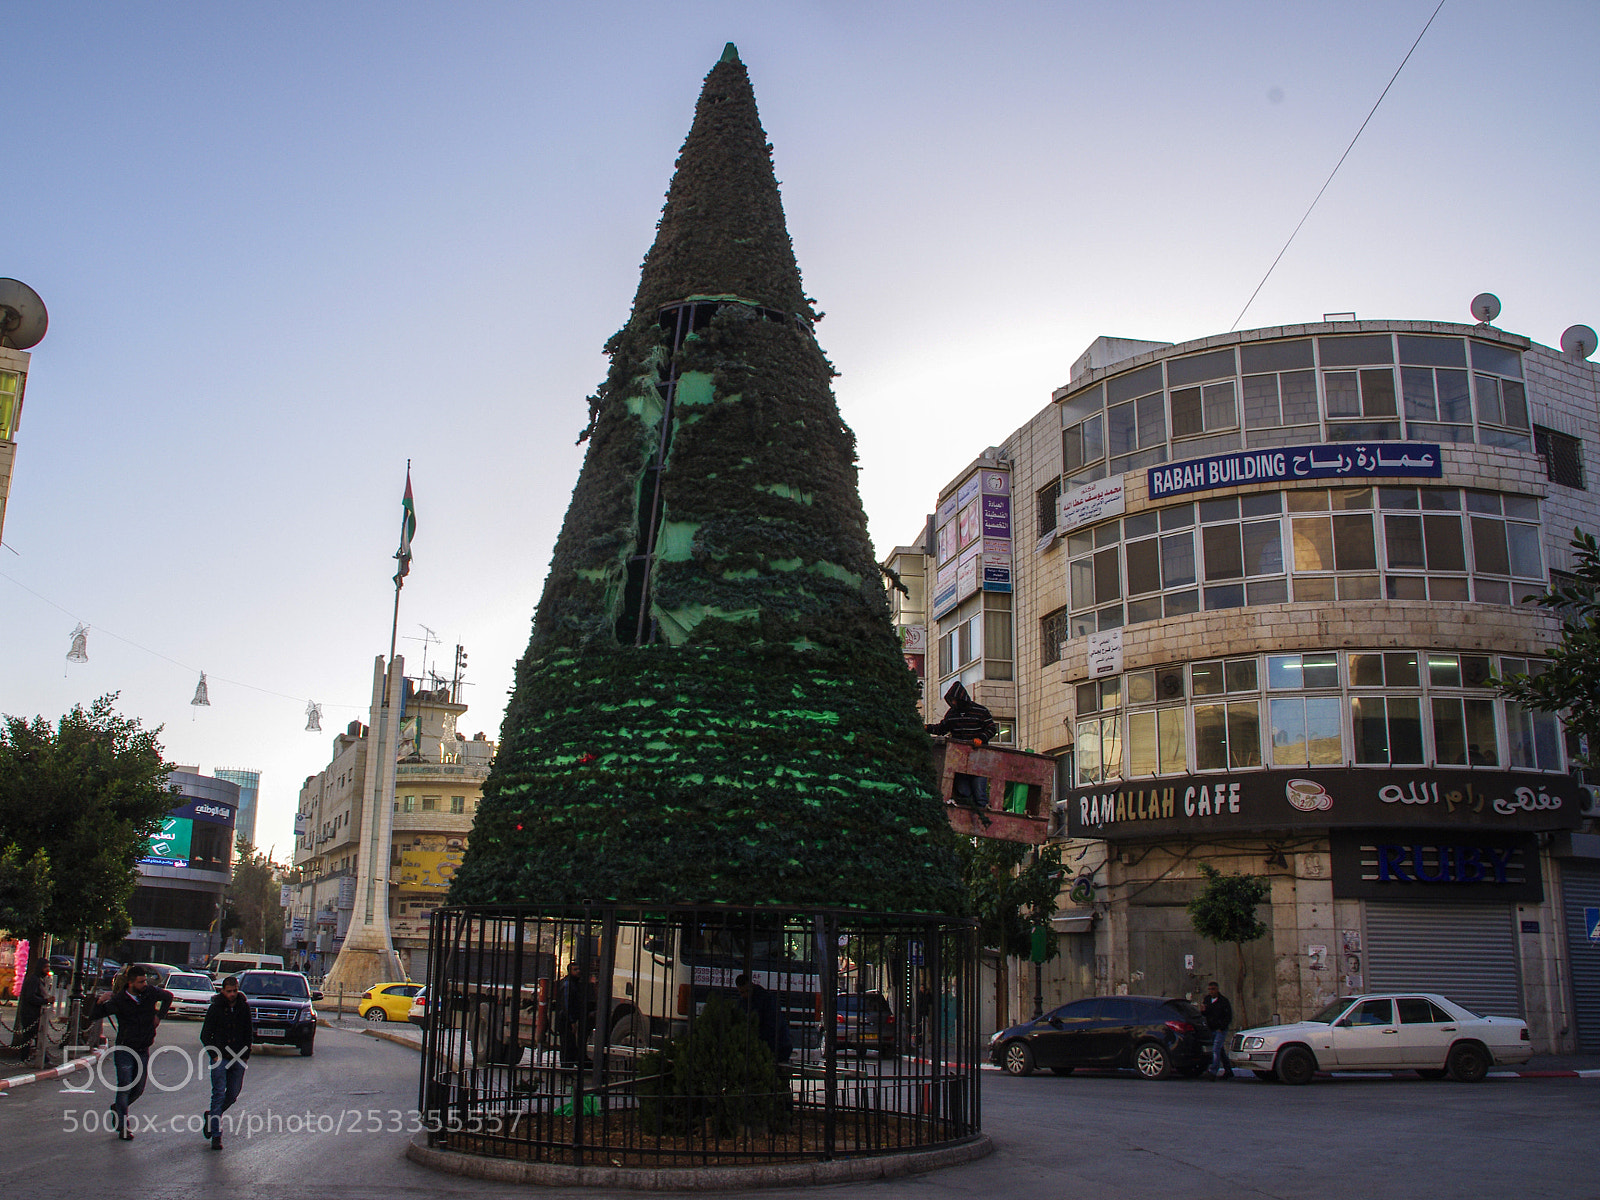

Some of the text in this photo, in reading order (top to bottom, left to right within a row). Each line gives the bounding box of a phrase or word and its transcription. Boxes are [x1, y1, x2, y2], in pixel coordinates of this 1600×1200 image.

[1153, 453, 1286, 494] RABAH BUILDING
[1293, 447, 1434, 476] عمارة رباح
[1080, 783, 1241, 826] RAMALLAH CAFE
[1378, 781, 1440, 805] الله
[1444, 783, 1484, 813] رام
[195, 804, 219, 817] الوطني
[1377, 845, 1515, 882] RUBY
